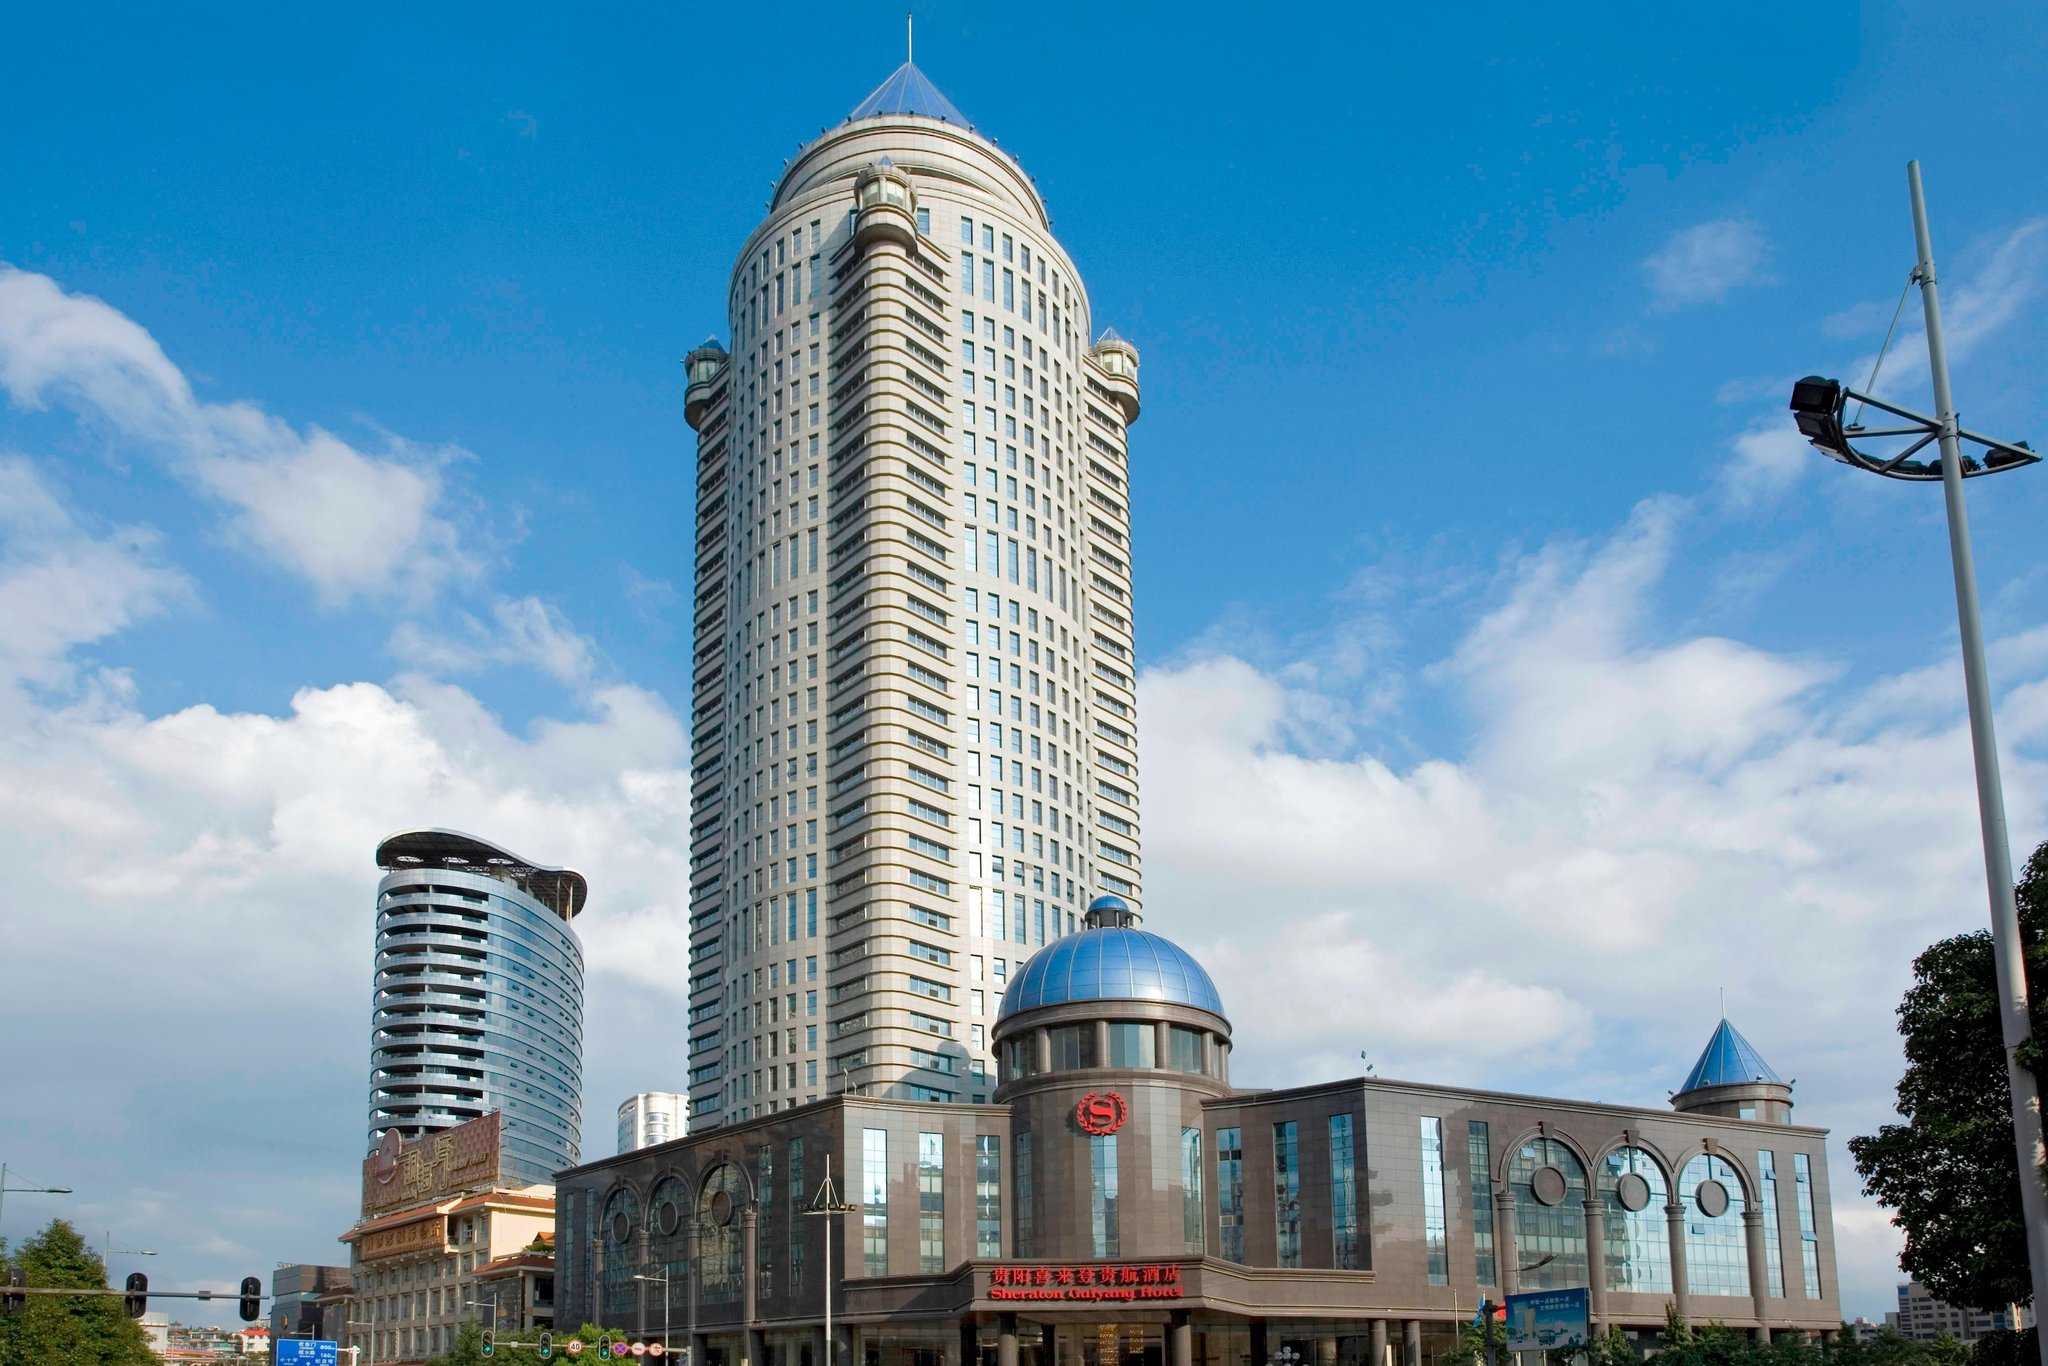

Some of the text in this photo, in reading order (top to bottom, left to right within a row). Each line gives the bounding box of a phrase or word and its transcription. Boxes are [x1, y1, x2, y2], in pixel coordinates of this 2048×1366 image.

[993, 1265, 1181, 1283] 贵阳喜来登贵航酒店
[991, 1286, 1184, 1302] Sheraton Guiyang Hotel
